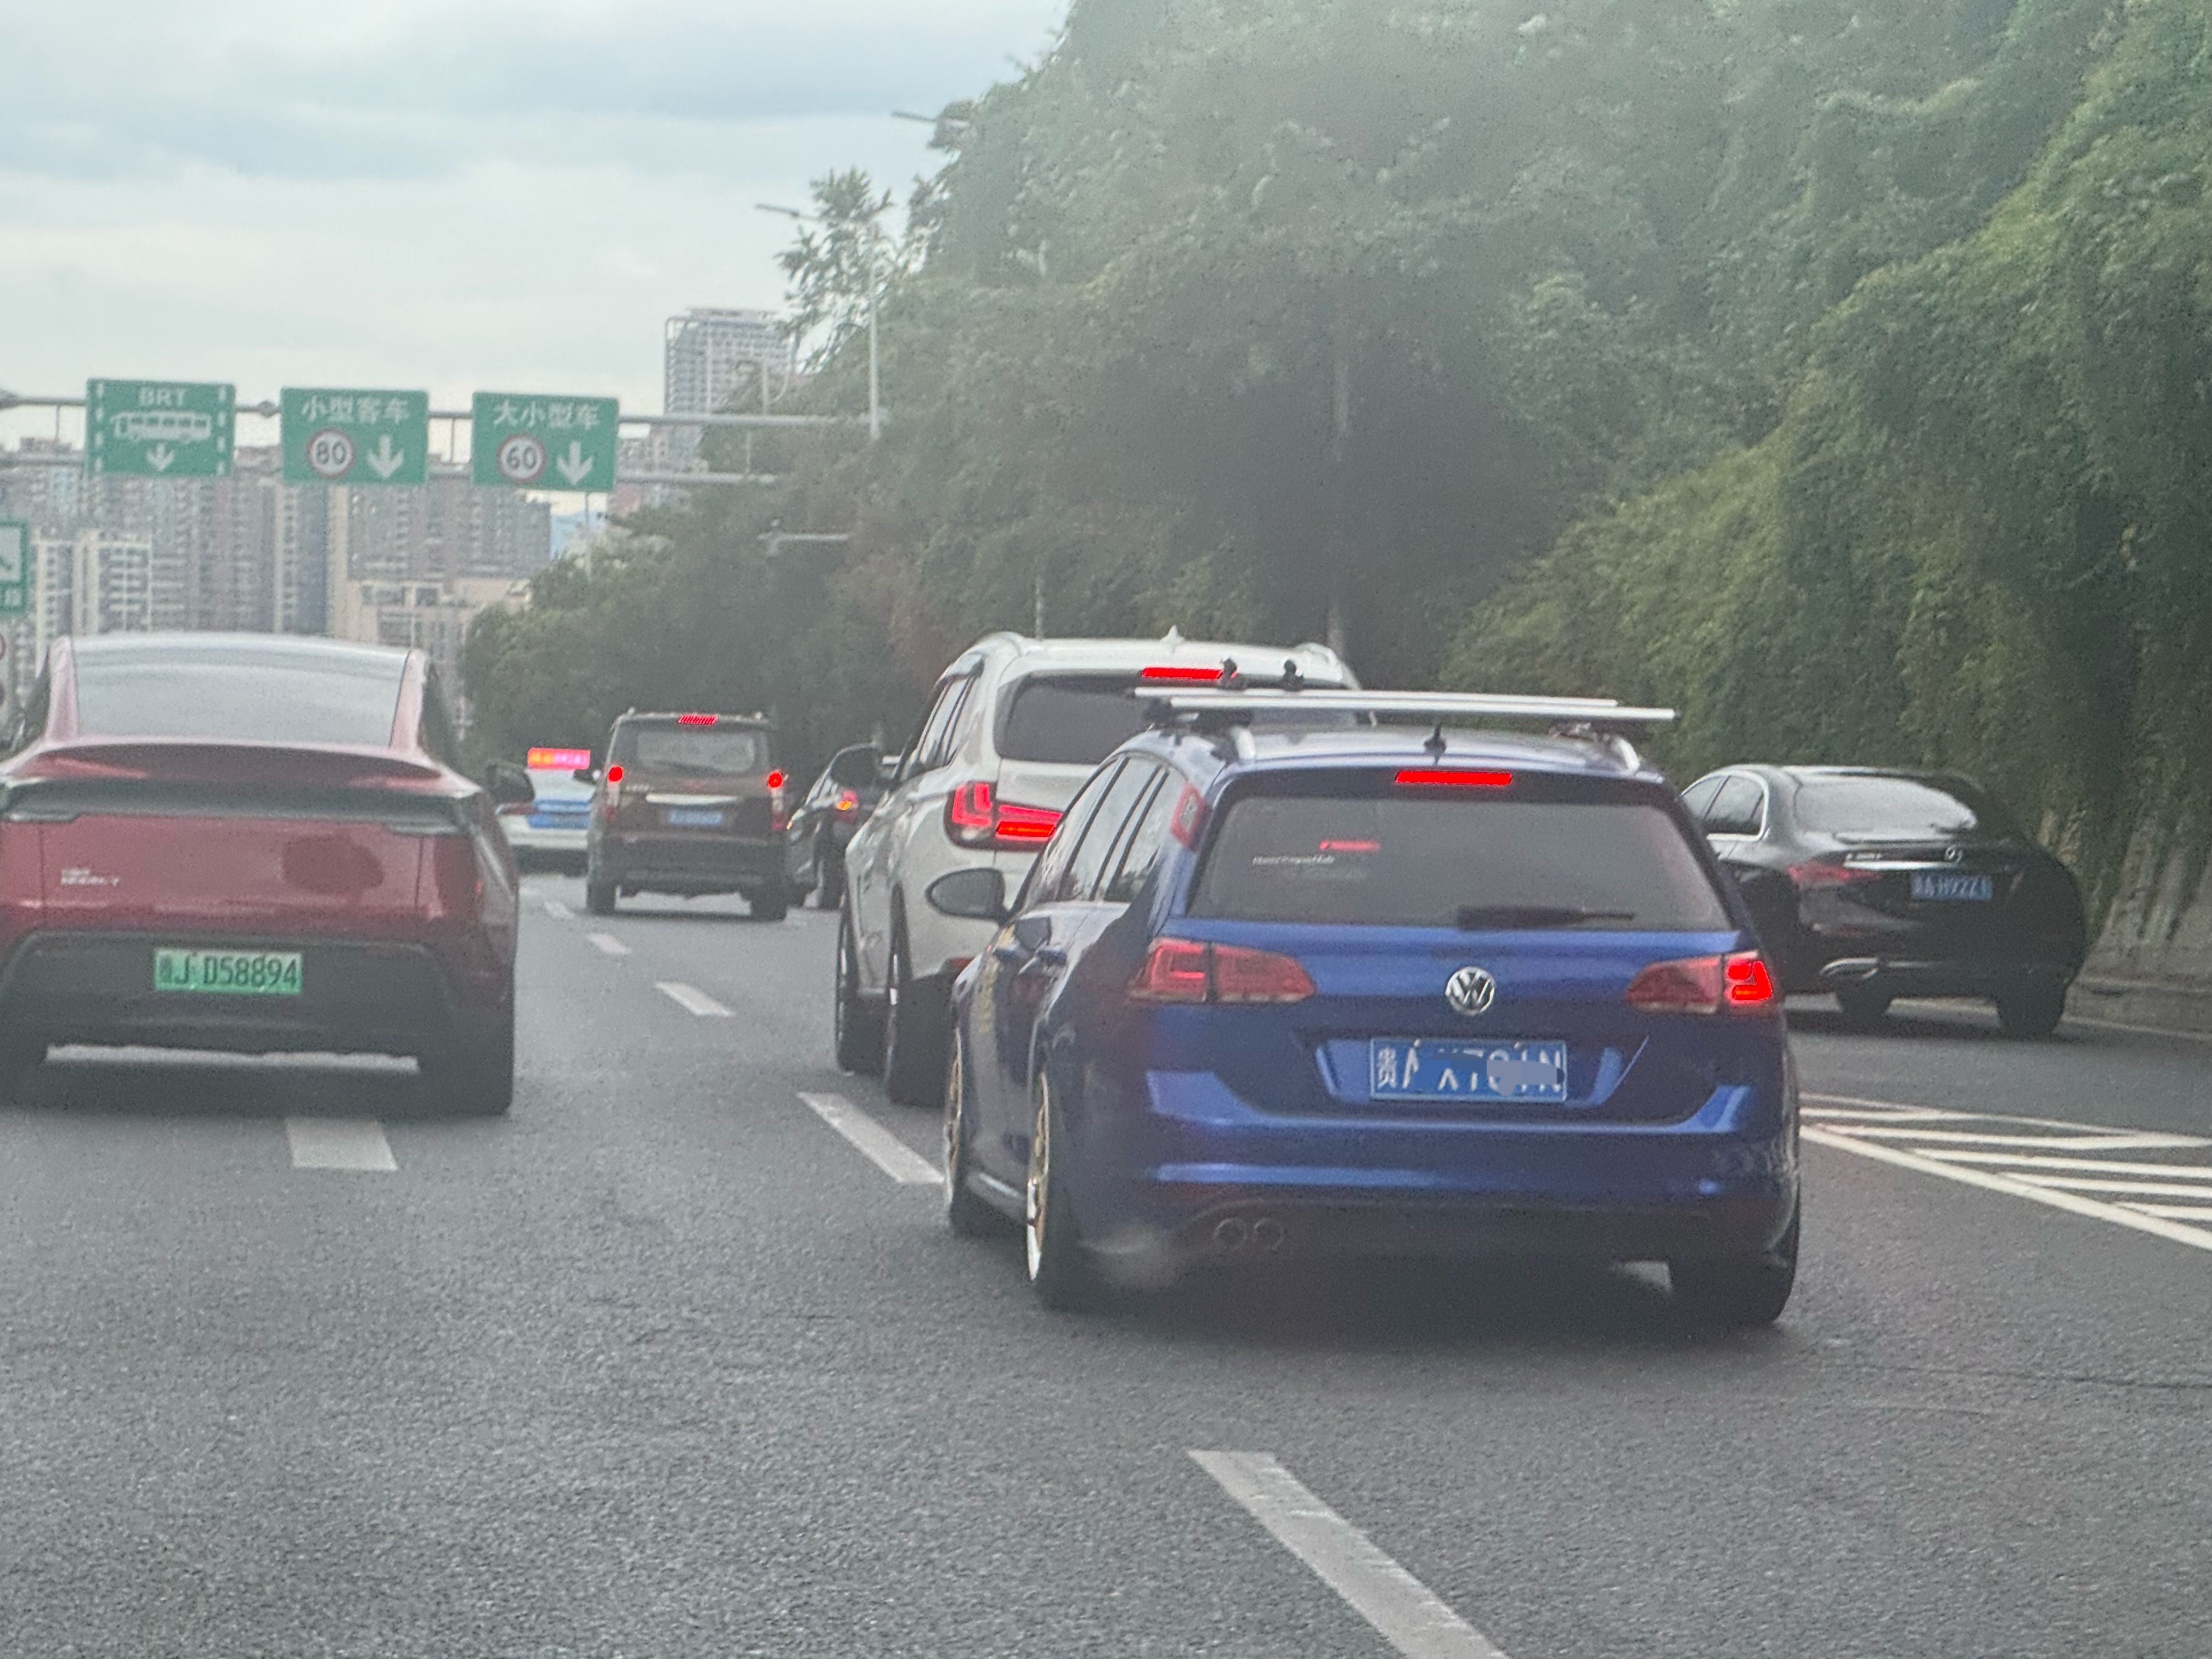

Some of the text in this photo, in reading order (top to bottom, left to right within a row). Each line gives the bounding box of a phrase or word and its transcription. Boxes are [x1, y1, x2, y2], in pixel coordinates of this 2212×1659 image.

[139, 386, 188, 407] BRT
[301, 394, 410, 426] 小型客车
[493, 399, 600, 431] 大小型车
[315, 441, 347, 466] 80
[506, 445, 538, 470] 60
